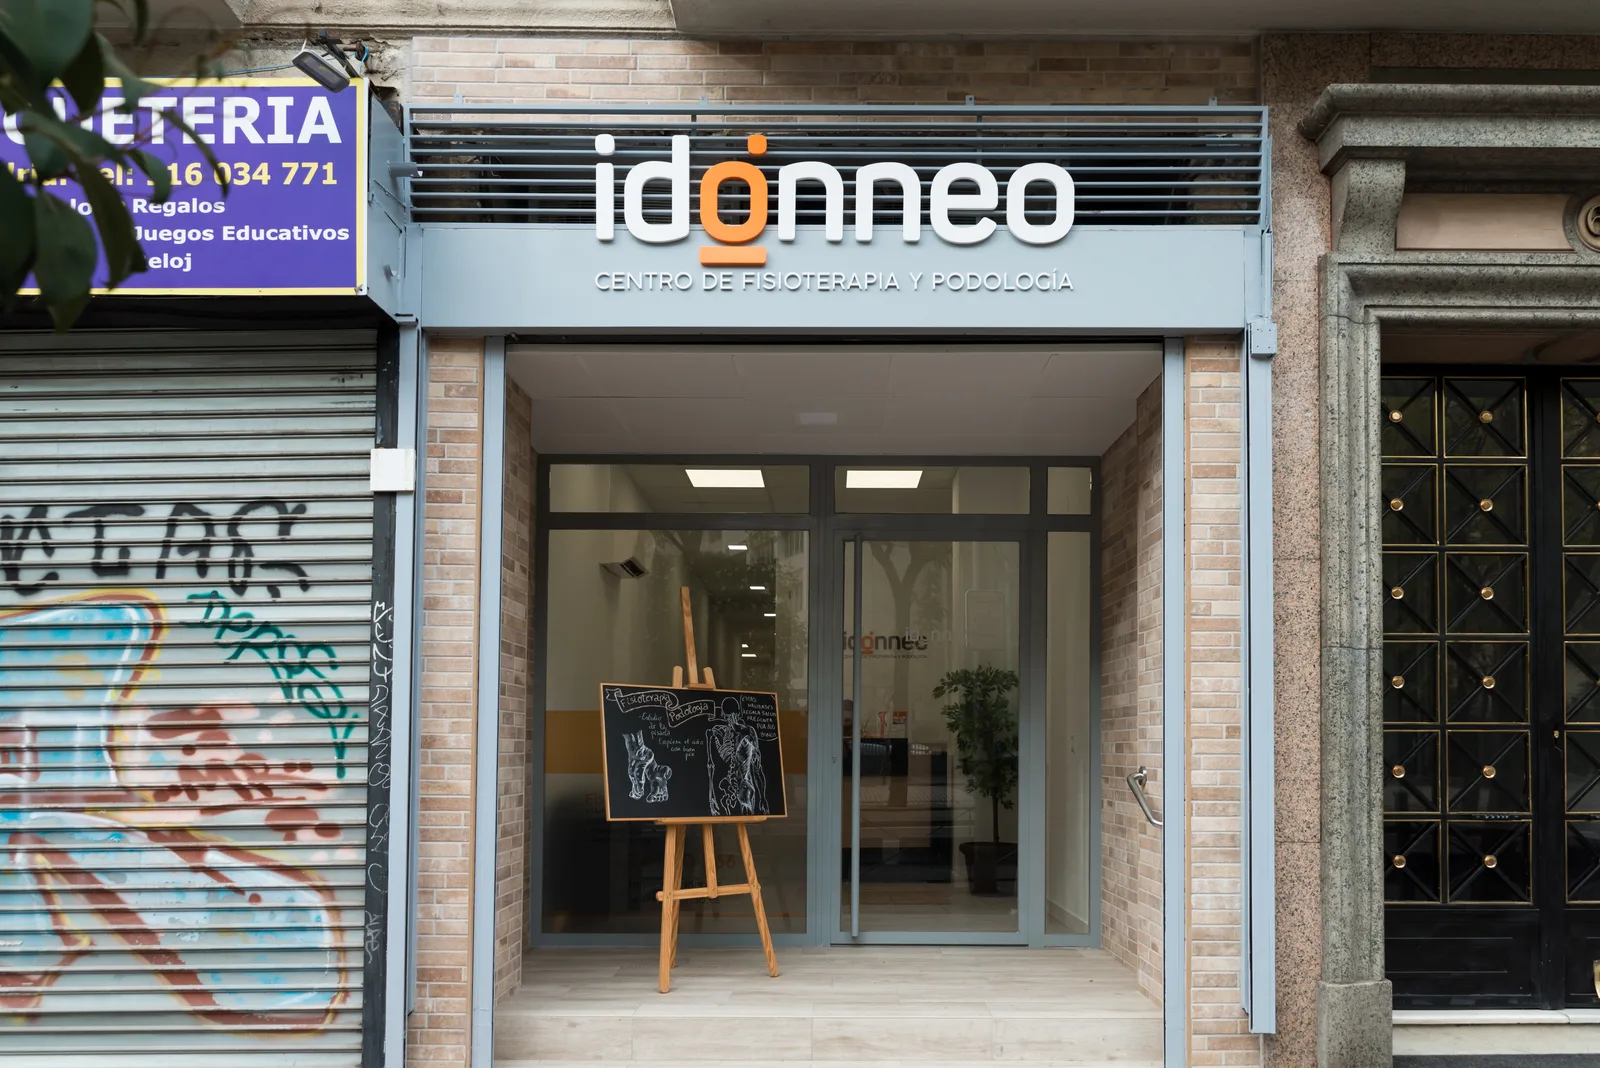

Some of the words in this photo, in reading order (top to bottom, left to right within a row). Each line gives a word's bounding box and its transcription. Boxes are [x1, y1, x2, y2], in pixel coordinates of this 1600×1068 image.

[147, 162, 202, 186] 16
[213, 162, 271, 186] 034
[281, 162, 338, 186] 771
[132, 198, 226, 217] Regalos
[223, 225, 350, 241] Educativos
[147, 253, 192, 271] eloj
[595, 272, 692, 291] CENTRO
[702, 272, 733, 291] DE
[742, 272, 900, 291] FISIOTERAPIA
[909, 272, 923, 291] Y
[932, 268, 1074, 291] PODOLOGÍA
[620, 692, 672, 708] Fisioterapia
